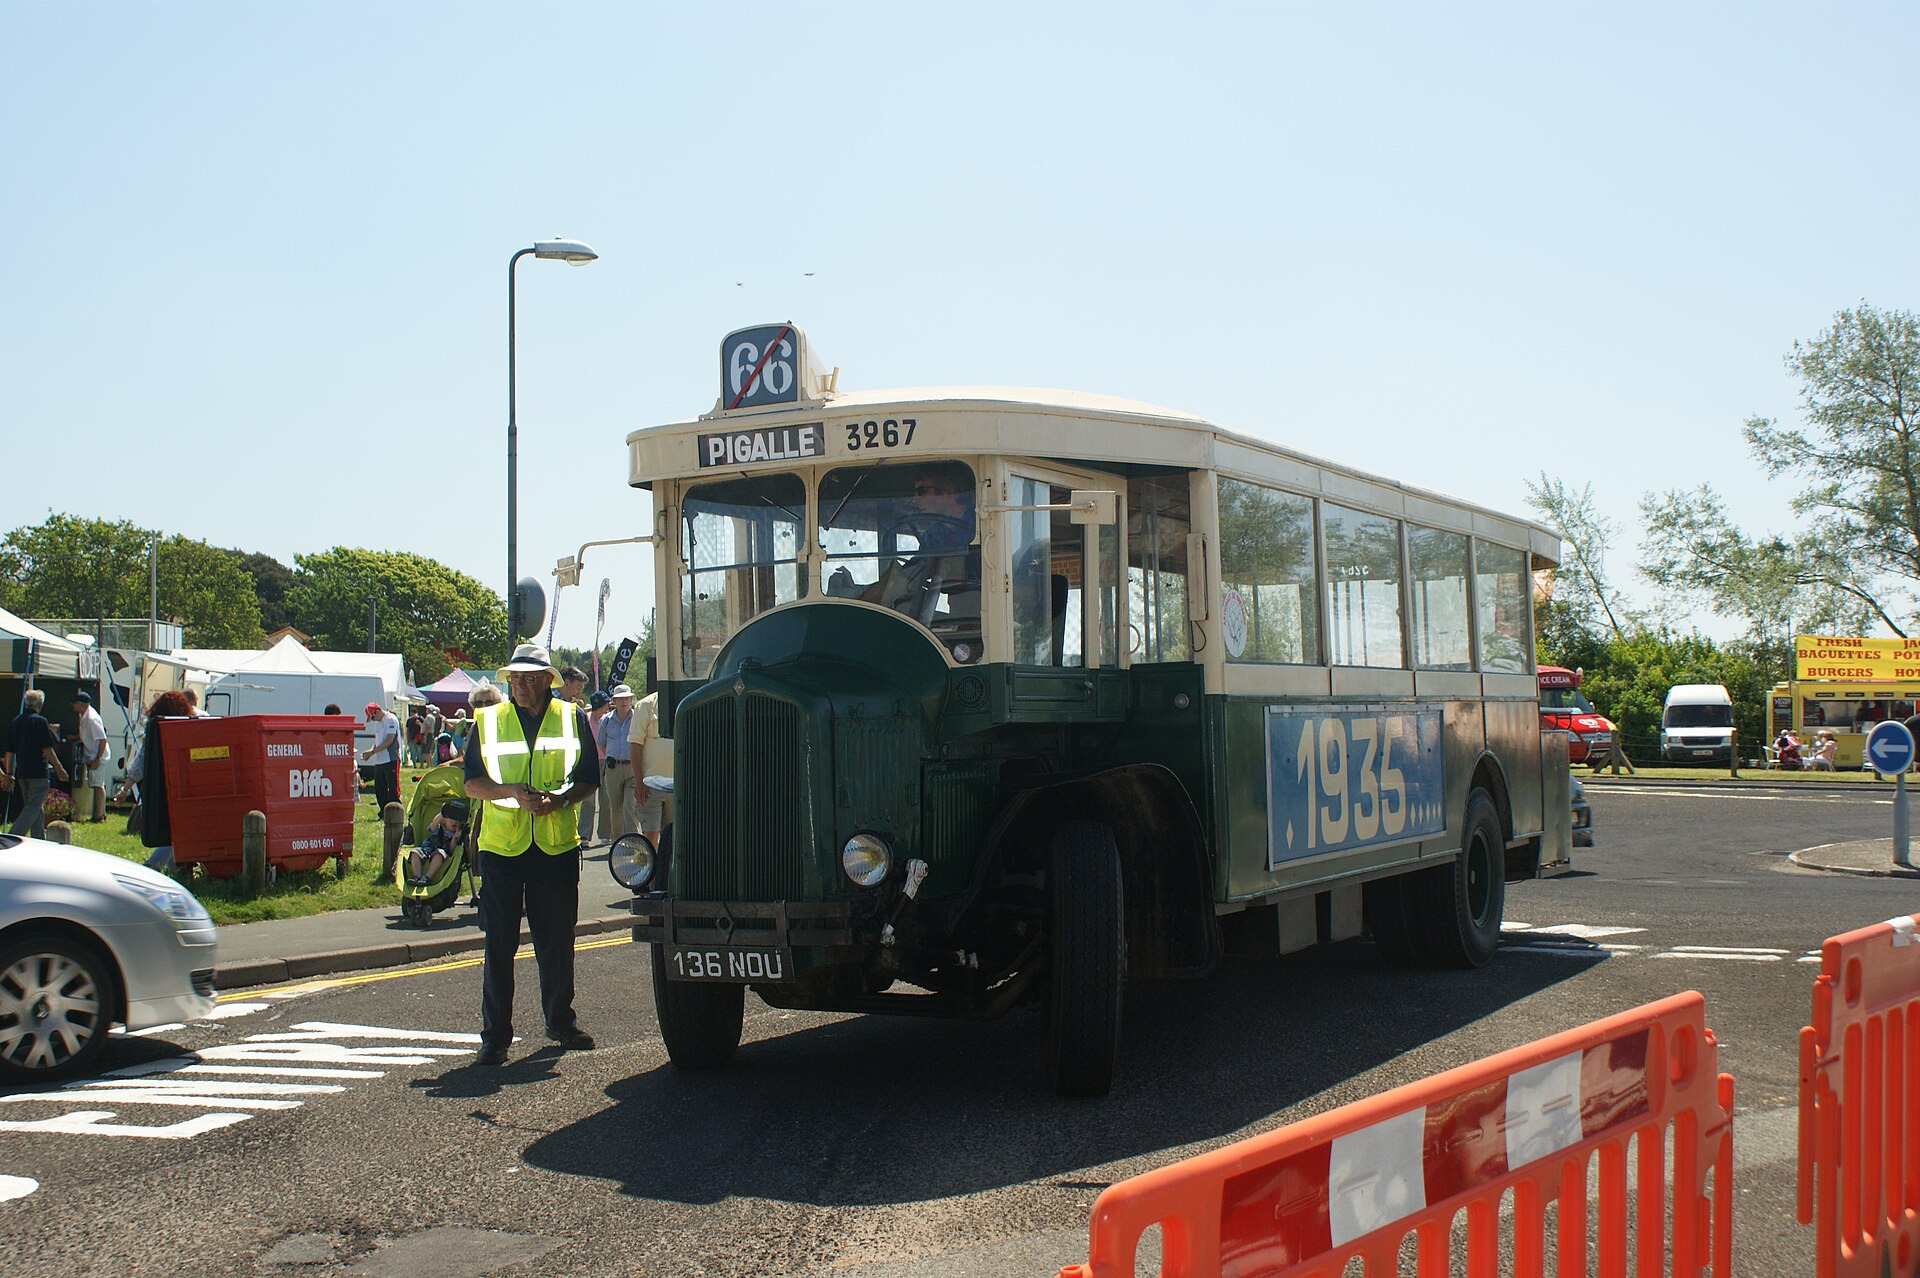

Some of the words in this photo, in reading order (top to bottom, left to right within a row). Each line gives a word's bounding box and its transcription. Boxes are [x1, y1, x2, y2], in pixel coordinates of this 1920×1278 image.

[731, 338, 793, 398] 66
[846, 419, 917, 450] 3267
[708, 427, 815, 466] PIGALLE
[1817, 638, 1862, 648] FRESH
[1903, 640, 1920, 649] JA
[1798, 650, 1881, 660] BAGUETTES
[1807, 668, 1873, 677] BURGERS
[267, 744, 303, 757] GENERAL
[324, 744, 349, 756] WASTE
[289, 769, 333, 798] Biffa
[673, 951, 722, 977] 136
[728, 951, 783, 979] NOU
